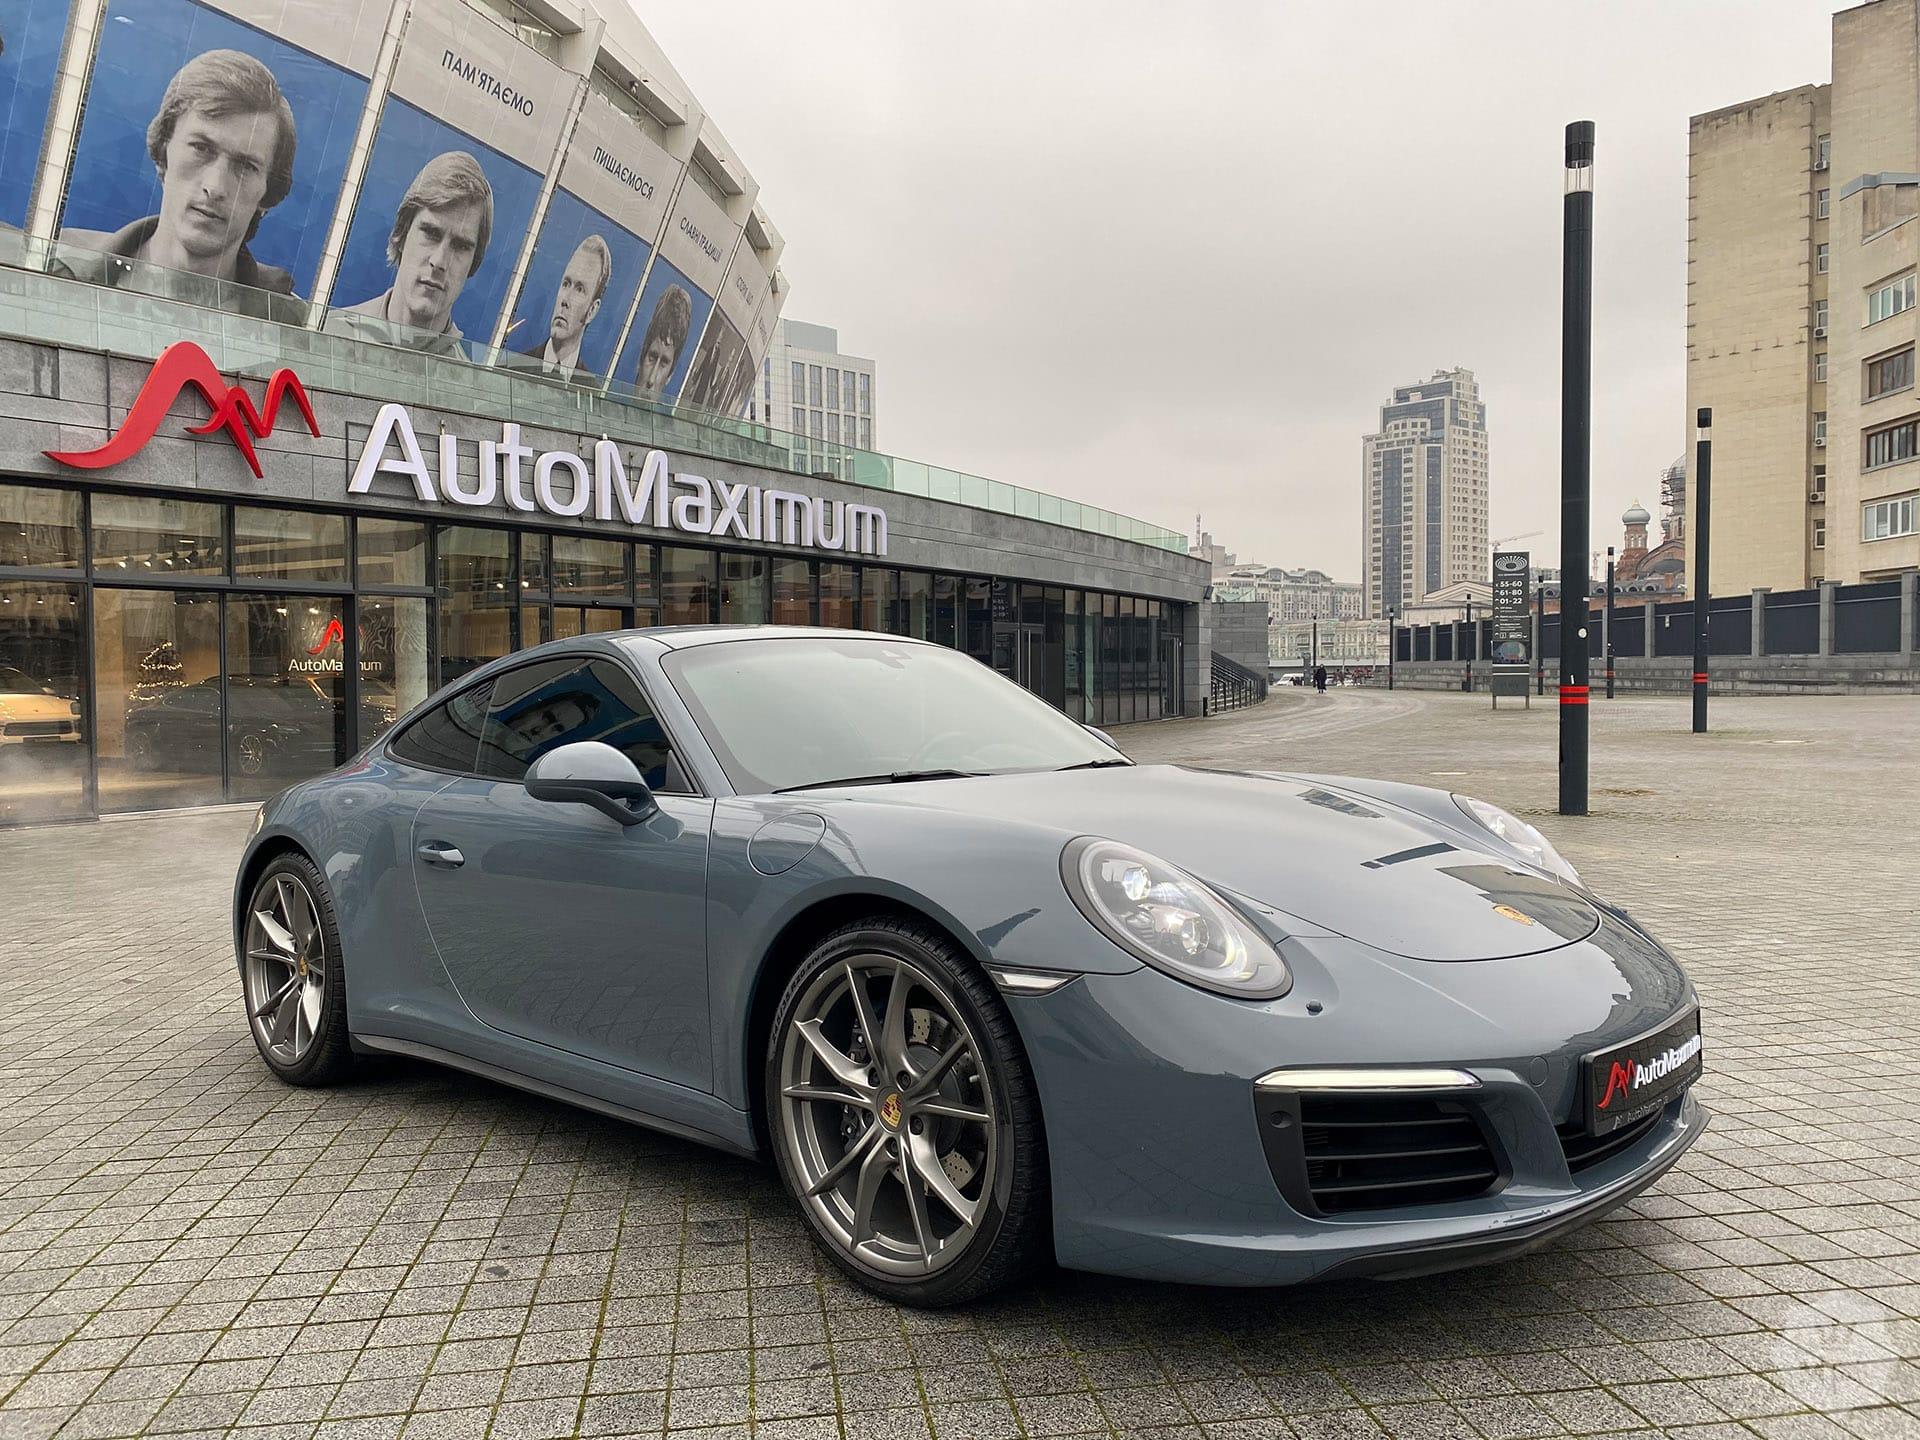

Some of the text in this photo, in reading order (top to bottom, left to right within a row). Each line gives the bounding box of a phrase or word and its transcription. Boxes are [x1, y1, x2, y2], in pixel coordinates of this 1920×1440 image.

[442, 49, 534, 116] ПАМ'ЯТАЄМО
[593, 146, 654, 200] ПИШАЄМОСЯ
[347, 403, 887, 556] AutoMaximum
[1500, 597, 1523, 605] 01-22
